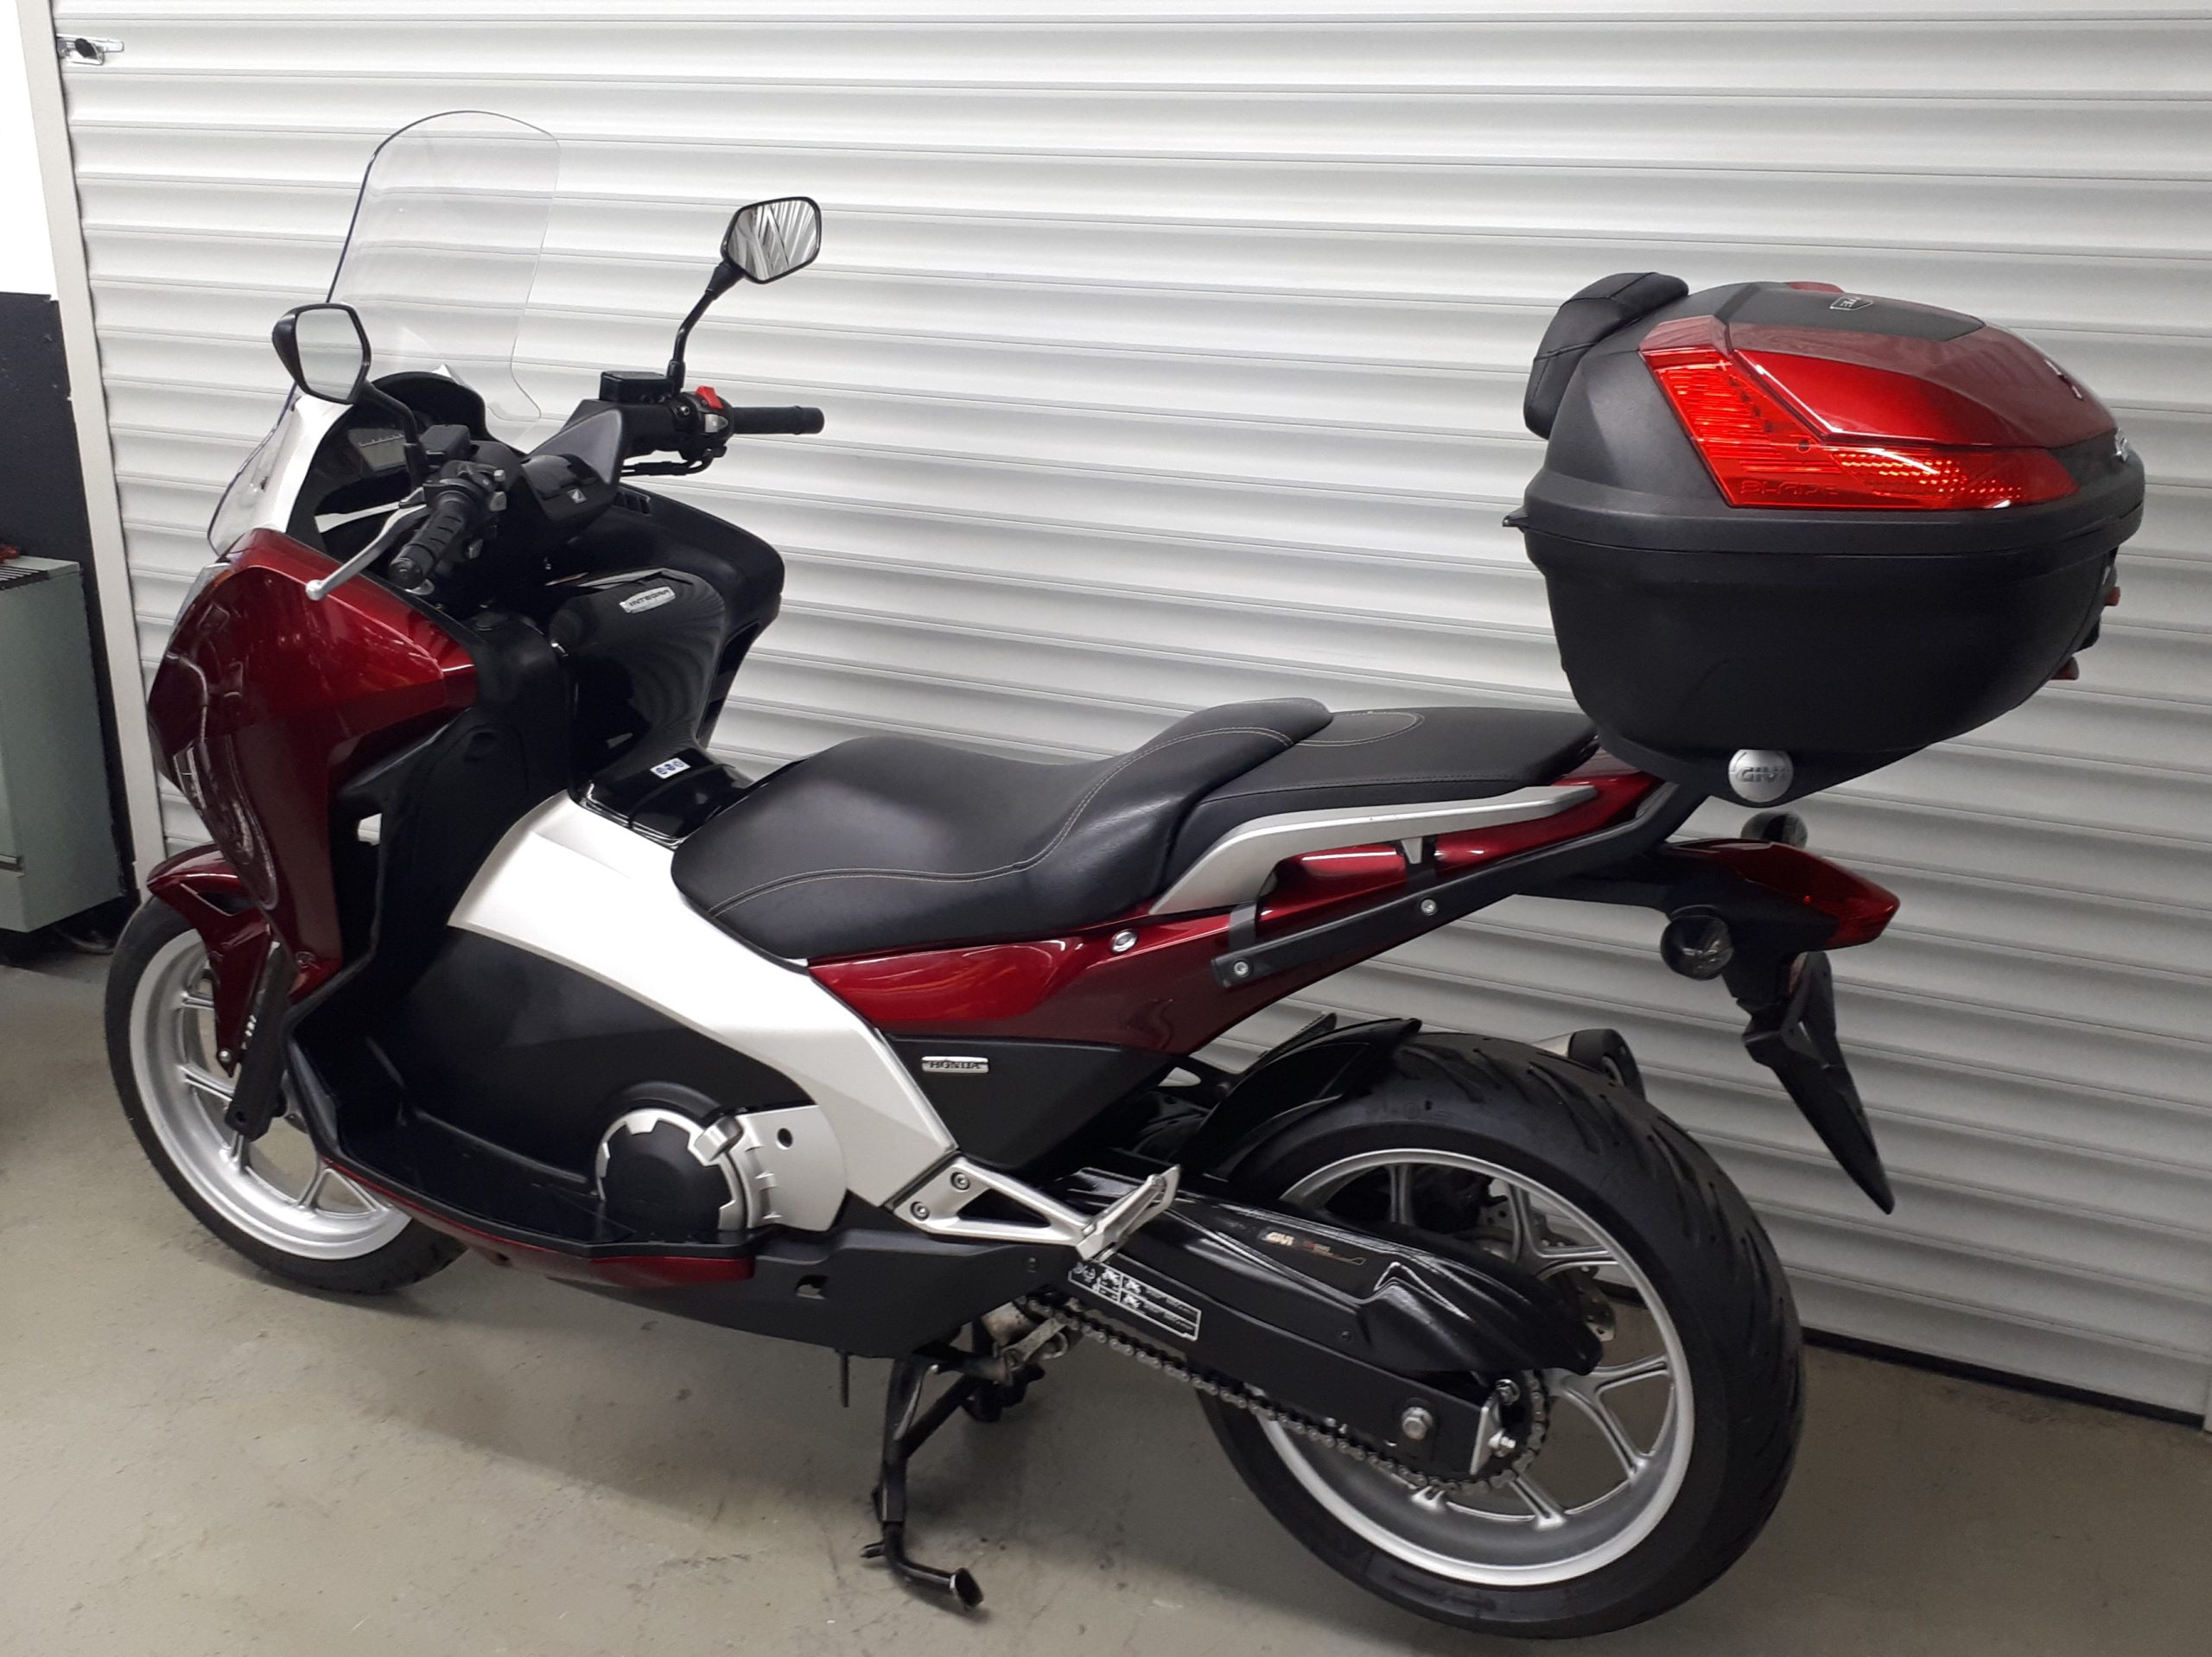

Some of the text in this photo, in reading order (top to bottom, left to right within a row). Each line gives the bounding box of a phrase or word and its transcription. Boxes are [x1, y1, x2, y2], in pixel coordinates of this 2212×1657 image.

[628, 589, 671, 607] INTEGRA
[1737, 766, 1788, 783] GIVI
[929, 1060, 982, 1070] HONDA
